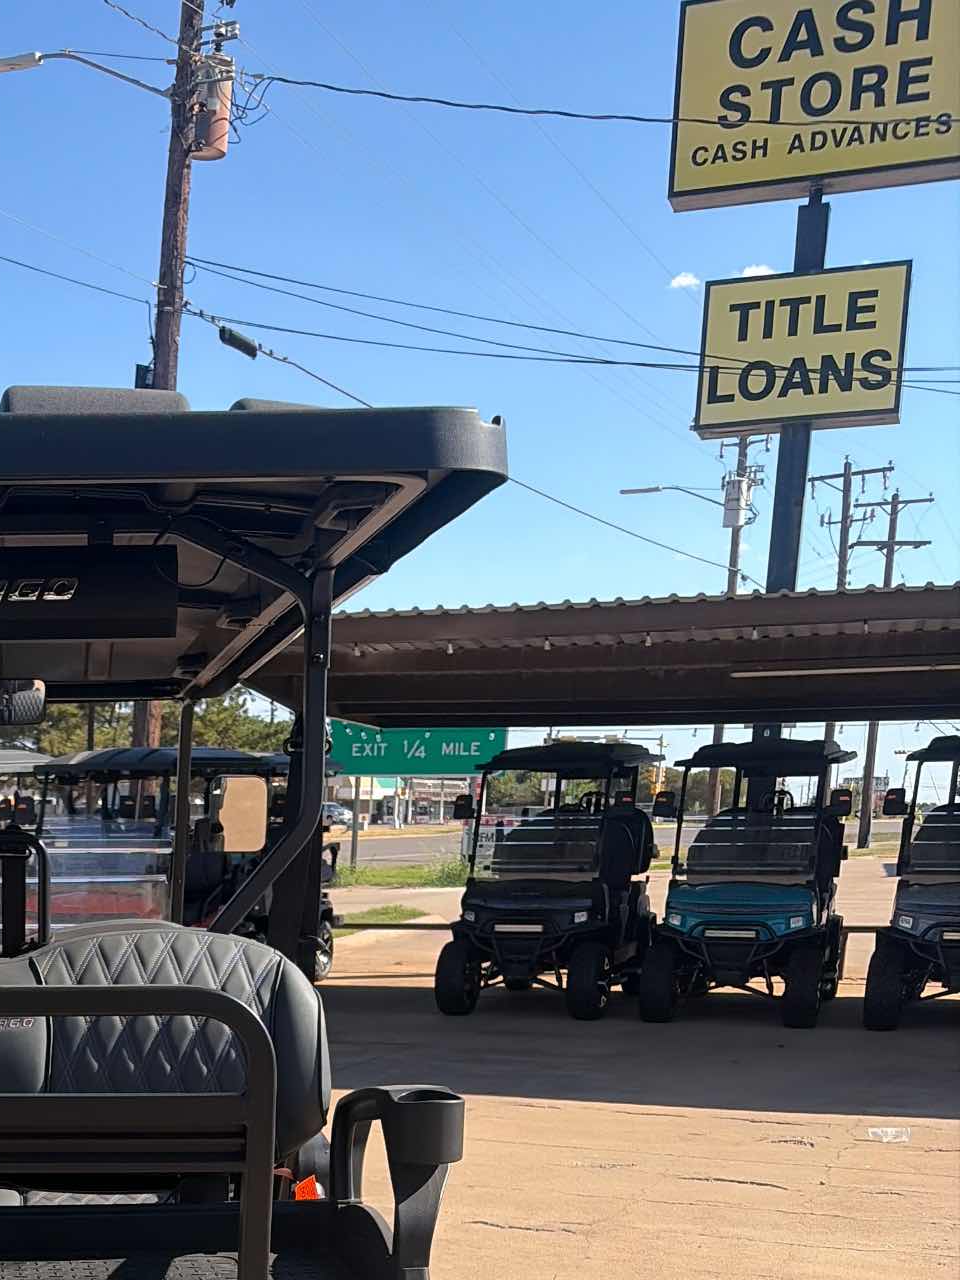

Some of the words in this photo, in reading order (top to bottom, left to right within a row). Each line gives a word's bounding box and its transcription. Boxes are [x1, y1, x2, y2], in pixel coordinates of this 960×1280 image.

[728, 0, 933, 69] CASH
[717, 56, 933, 129] STORE
[691, 138, 769, 167] CASH
[787, 112, 953, 154] ADVANCES
[728, 289, 880, 343] TITLE
[706, 349, 893, 405] LOANS
[351, 743, 388, 757] EXIT
[441, 742, 481, 756] MILE
